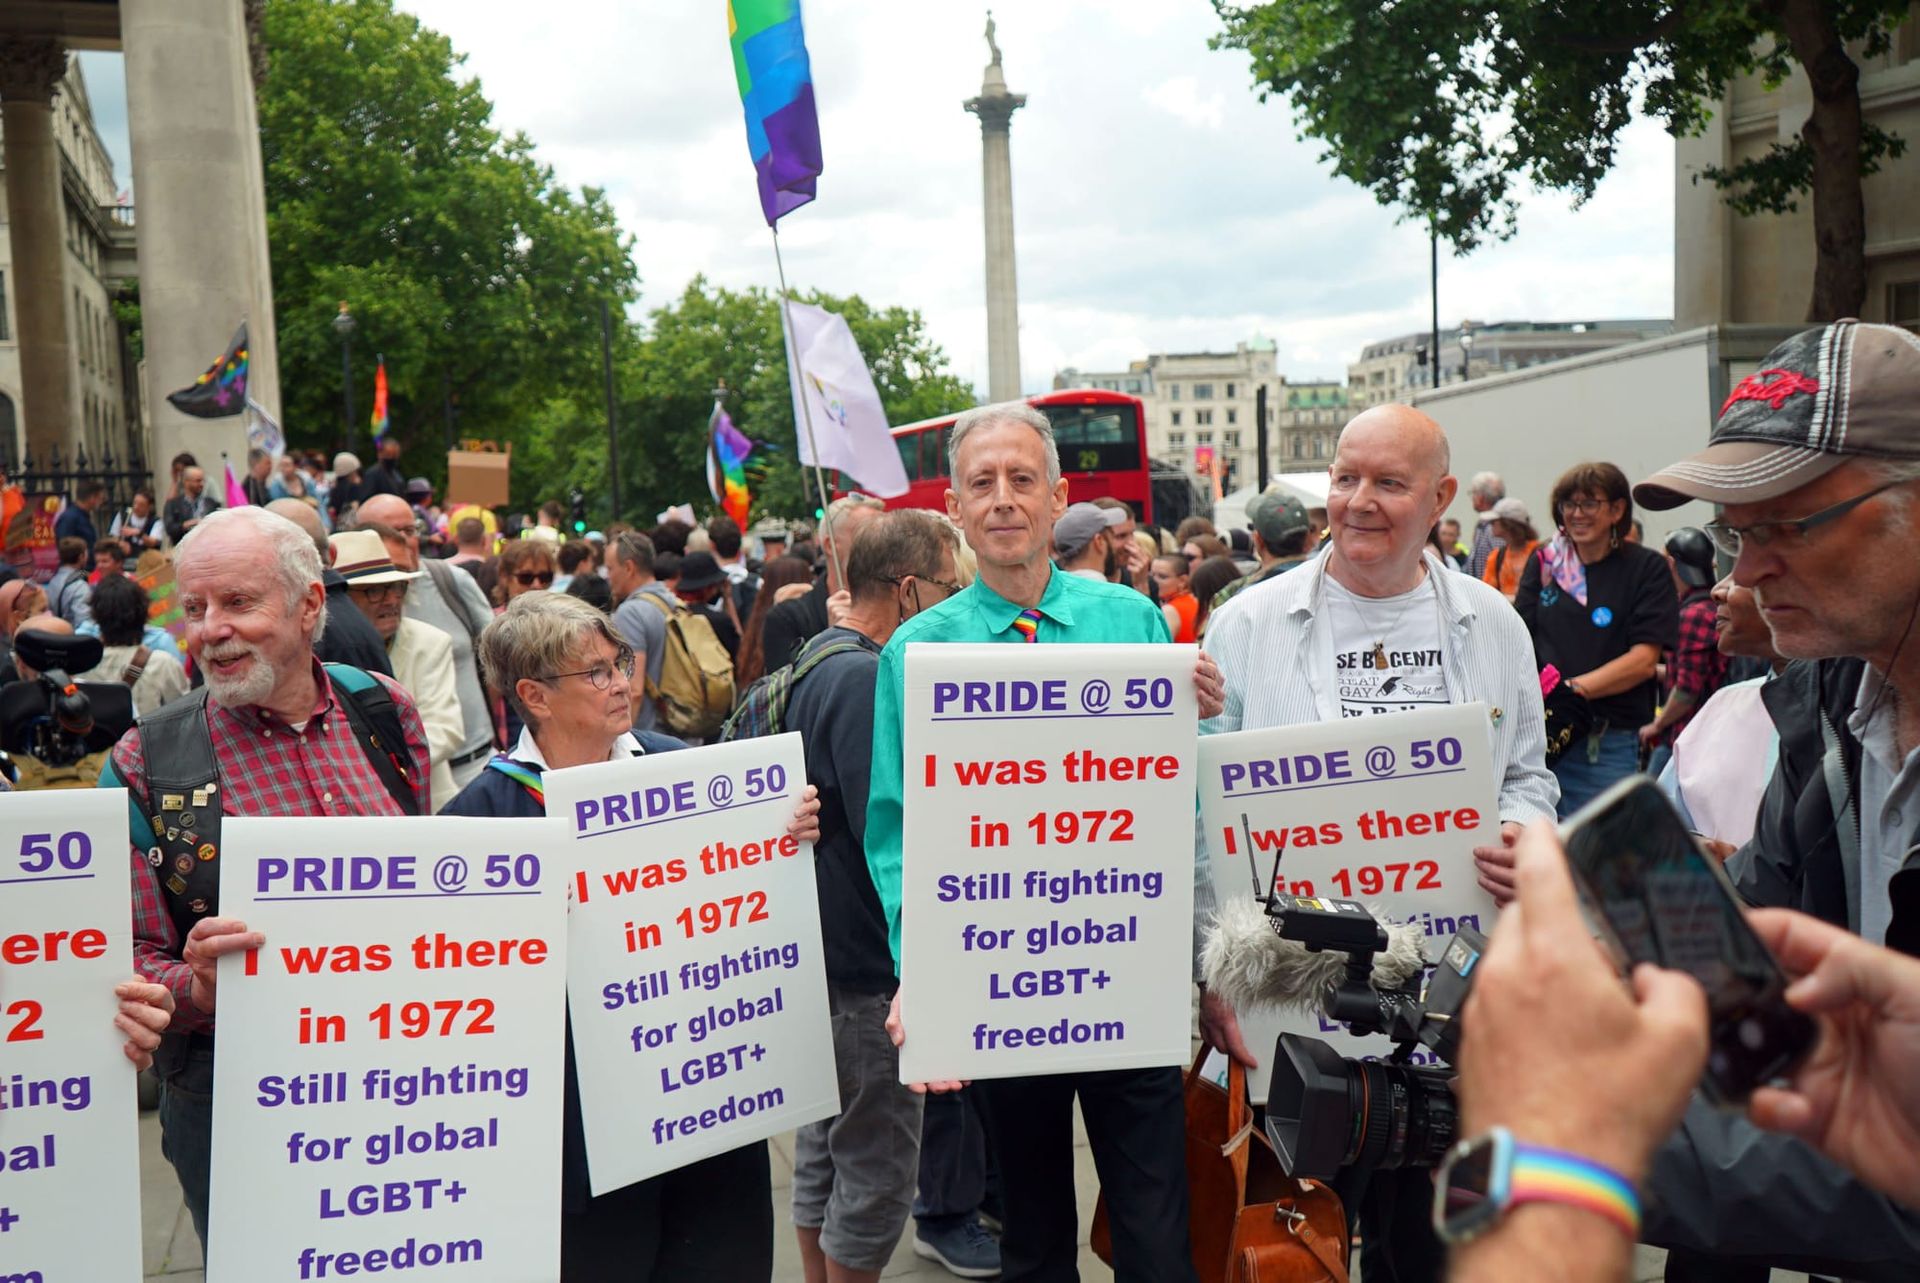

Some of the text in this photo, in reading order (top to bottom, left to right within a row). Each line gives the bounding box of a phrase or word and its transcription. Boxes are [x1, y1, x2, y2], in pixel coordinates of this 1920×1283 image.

[1078, 450, 1099, 469] 29
[934, 677, 1173, 714] PRIDE @ 50
[1340, 686, 1373, 698] GAY
[925, 749, 1180, 788] I was there
[1222, 737, 1462, 790] PRIDE @ 50
[575, 764, 786, 832] PRIDE @ 50
[970, 809, 1134, 848] in 1972
[1223, 807, 1481, 855] I was there
[19, 831, 92, 873] 50
[257, 853, 541, 893] PRIDE @ 50
[576, 833, 799, 904] I was there
[938, 867, 1163, 904] Still fighting
[1331, 860, 1442, 897] 1972
[624, 890, 769, 953] in 1972
[962, 915, 1137, 955] for global
[244, 933, 548, 977] I was there
[602, 943, 800, 1010] Still fighting
[989, 967, 1110, 1000] LGBT+
[299, 998, 495, 1045] in 1972
[631, 986, 783, 1052] for global
[973, 1018, 1125, 1051] freedom
[257, 1063, 530, 1108] Still fighting
[660, 1042, 767, 1094] LGBT+
[652, 1086, 784, 1145] freedom
[0, 1134, 56, 1173] al
[287, 1118, 498, 1165] for global
[319, 1178, 467, 1219] LGBT+
[297, 1238, 483, 1280] freedom
